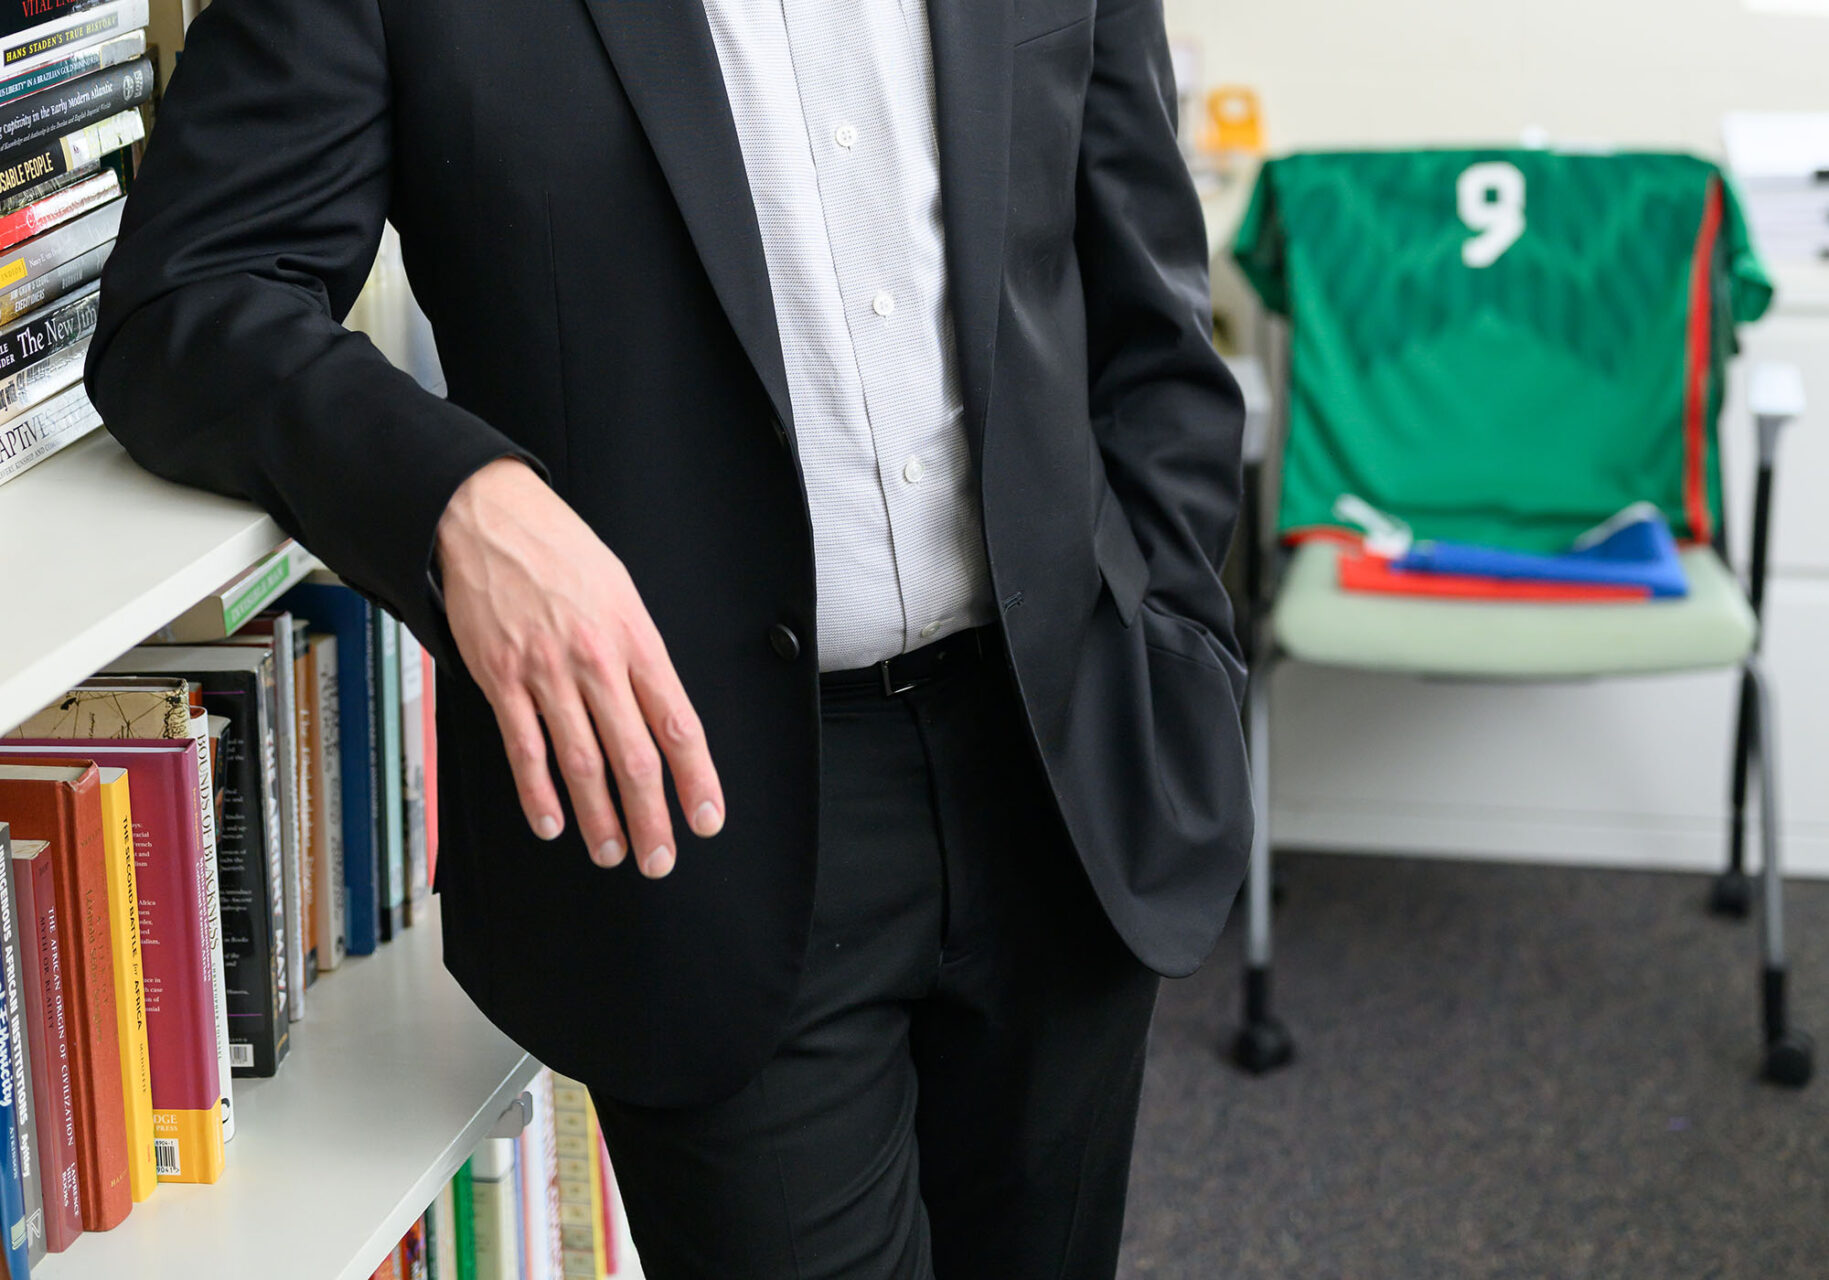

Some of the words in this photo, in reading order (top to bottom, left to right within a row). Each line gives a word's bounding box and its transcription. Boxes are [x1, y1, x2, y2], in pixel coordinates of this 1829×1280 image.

[6, 47, 27, 62] HANS
[29, 34, 63, 54] STADEN'S
[65, 27, 84, 42] TRUE
[86, 15, 117, 34] HISTORY
[37, 70, 61, 85] BRAZILIAN
[3, 111, 33, 135] Captivity
[33, 108, 40, 122] in
[40, 104, 50, 119] the
[50, 98, 68, 118] Early
[24, 152, 54, 182] PEOPLE
[1456, 161, 1526, 268] 9
[17, 326, 44, 359] The
[46, 317, 74, 346] New
[195, 733, 211, 811] BOUNDS
[264, 729, 276, 782] THE
[201, 814, 212, 834] OF
[267, 797, 284, 915] ANCIENT
[194, 861, 202, 906] Colonial
[198, 856, 207, 916] Multiracial
[202, 843, 220, 950] BLACKNESS
[38, 916, 48, 951] MYTH
[47, 907, 56, 932] THE
[123, 846, 133, 904] SECOND
[128, 906, 137, 956] BATTLE
[133, 980, 142, 1029] AFRICA
[197, 908, 205, 945] French
[202, 918, 211, 967] Identities
[4, 945, 18, 1012] AFRICAN
[42, 957, 50, 975] OR
[49, 939, 60, 989] AFRICAN
[200, 948, 208, 982] Africa
[206, 969, 211, 980] in
[273, 928, 288, 1012] MAYA
[43, 980, 55, 1029] REALITY
[54, 994, 65, 1037] ORIGIN
[9, 1014, 28, 1124] INSTITUTIONS
[59, 1043, 66, 1059] OF
[59, 1063, 74, 1146] CIVILIZATION
[7, 1127, 20, 1179] ATKINSON
[60, 1171, 69, 1206] BOOKS
[69, 1162, 80, 1216] LAWRENCE
